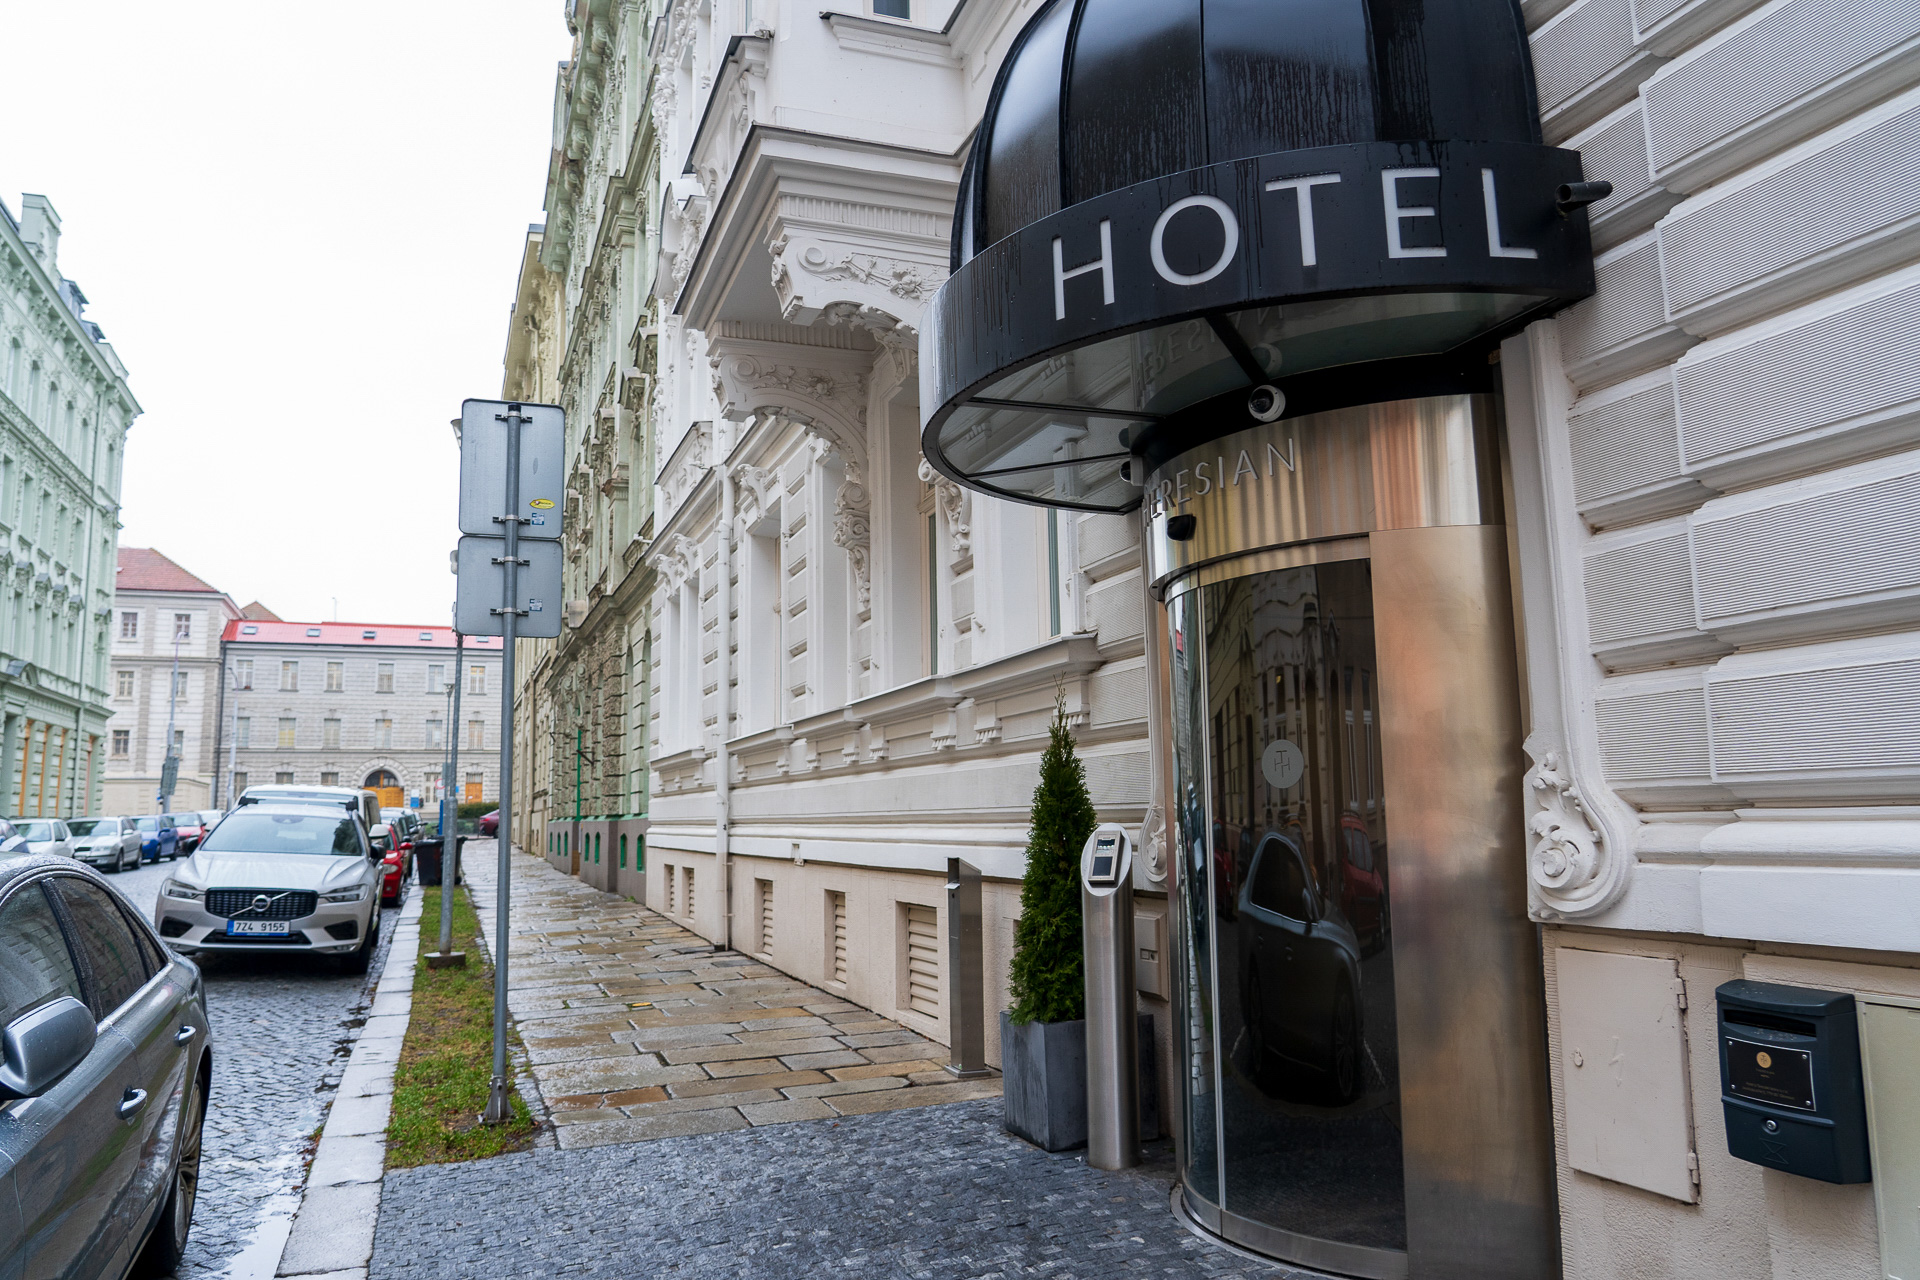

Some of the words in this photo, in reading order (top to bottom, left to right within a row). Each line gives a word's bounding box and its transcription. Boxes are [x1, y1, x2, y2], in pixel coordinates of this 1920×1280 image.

[1052, 167, 1538, 321] HOTEL
[236, 922, 253, 931] 7Z4
[261, 922, 285, 931] 9155
